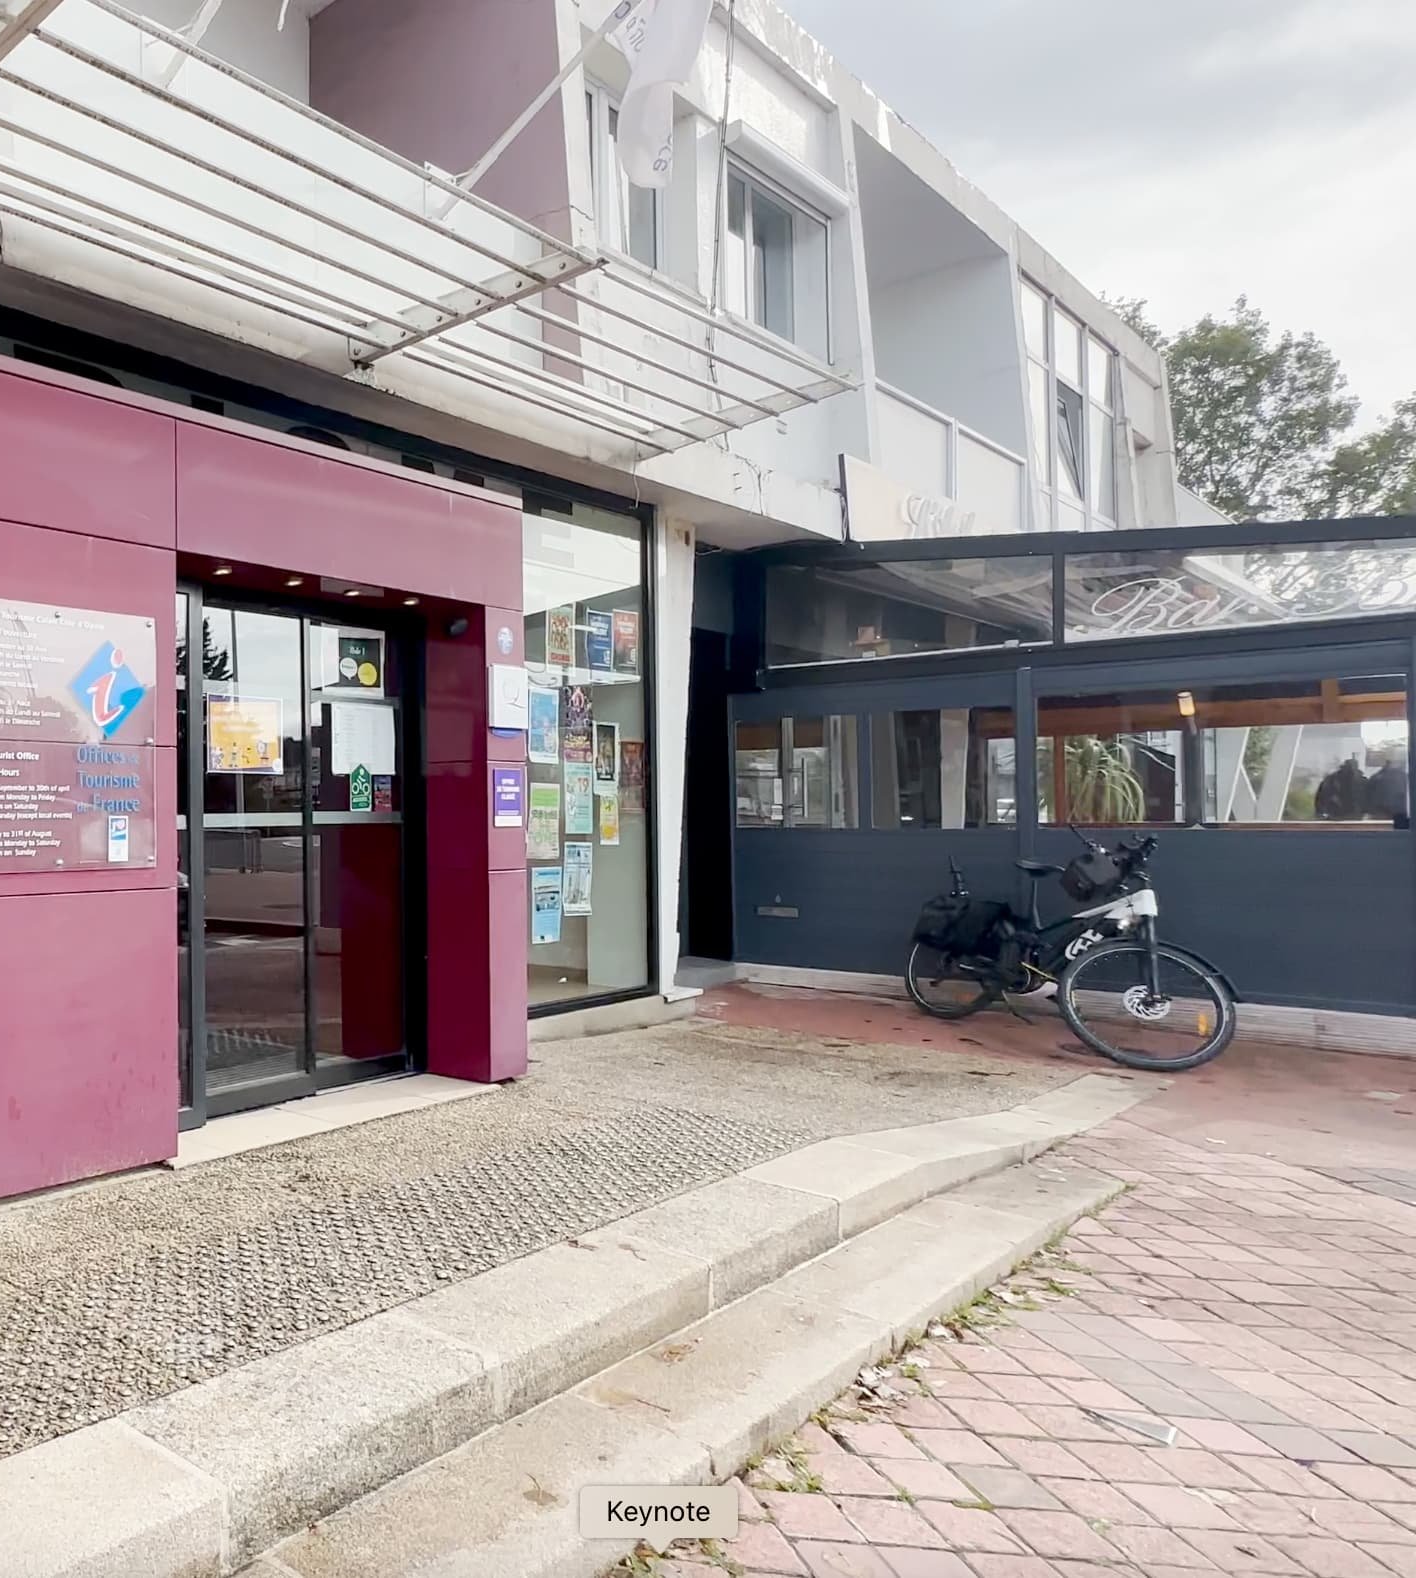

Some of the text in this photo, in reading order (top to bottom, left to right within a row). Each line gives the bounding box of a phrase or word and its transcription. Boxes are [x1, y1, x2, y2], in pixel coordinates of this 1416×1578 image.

[16, 751, 40, 761] Office
[76, 769, 140, 789] Tourisme
[92, 793, 141, 813] France
